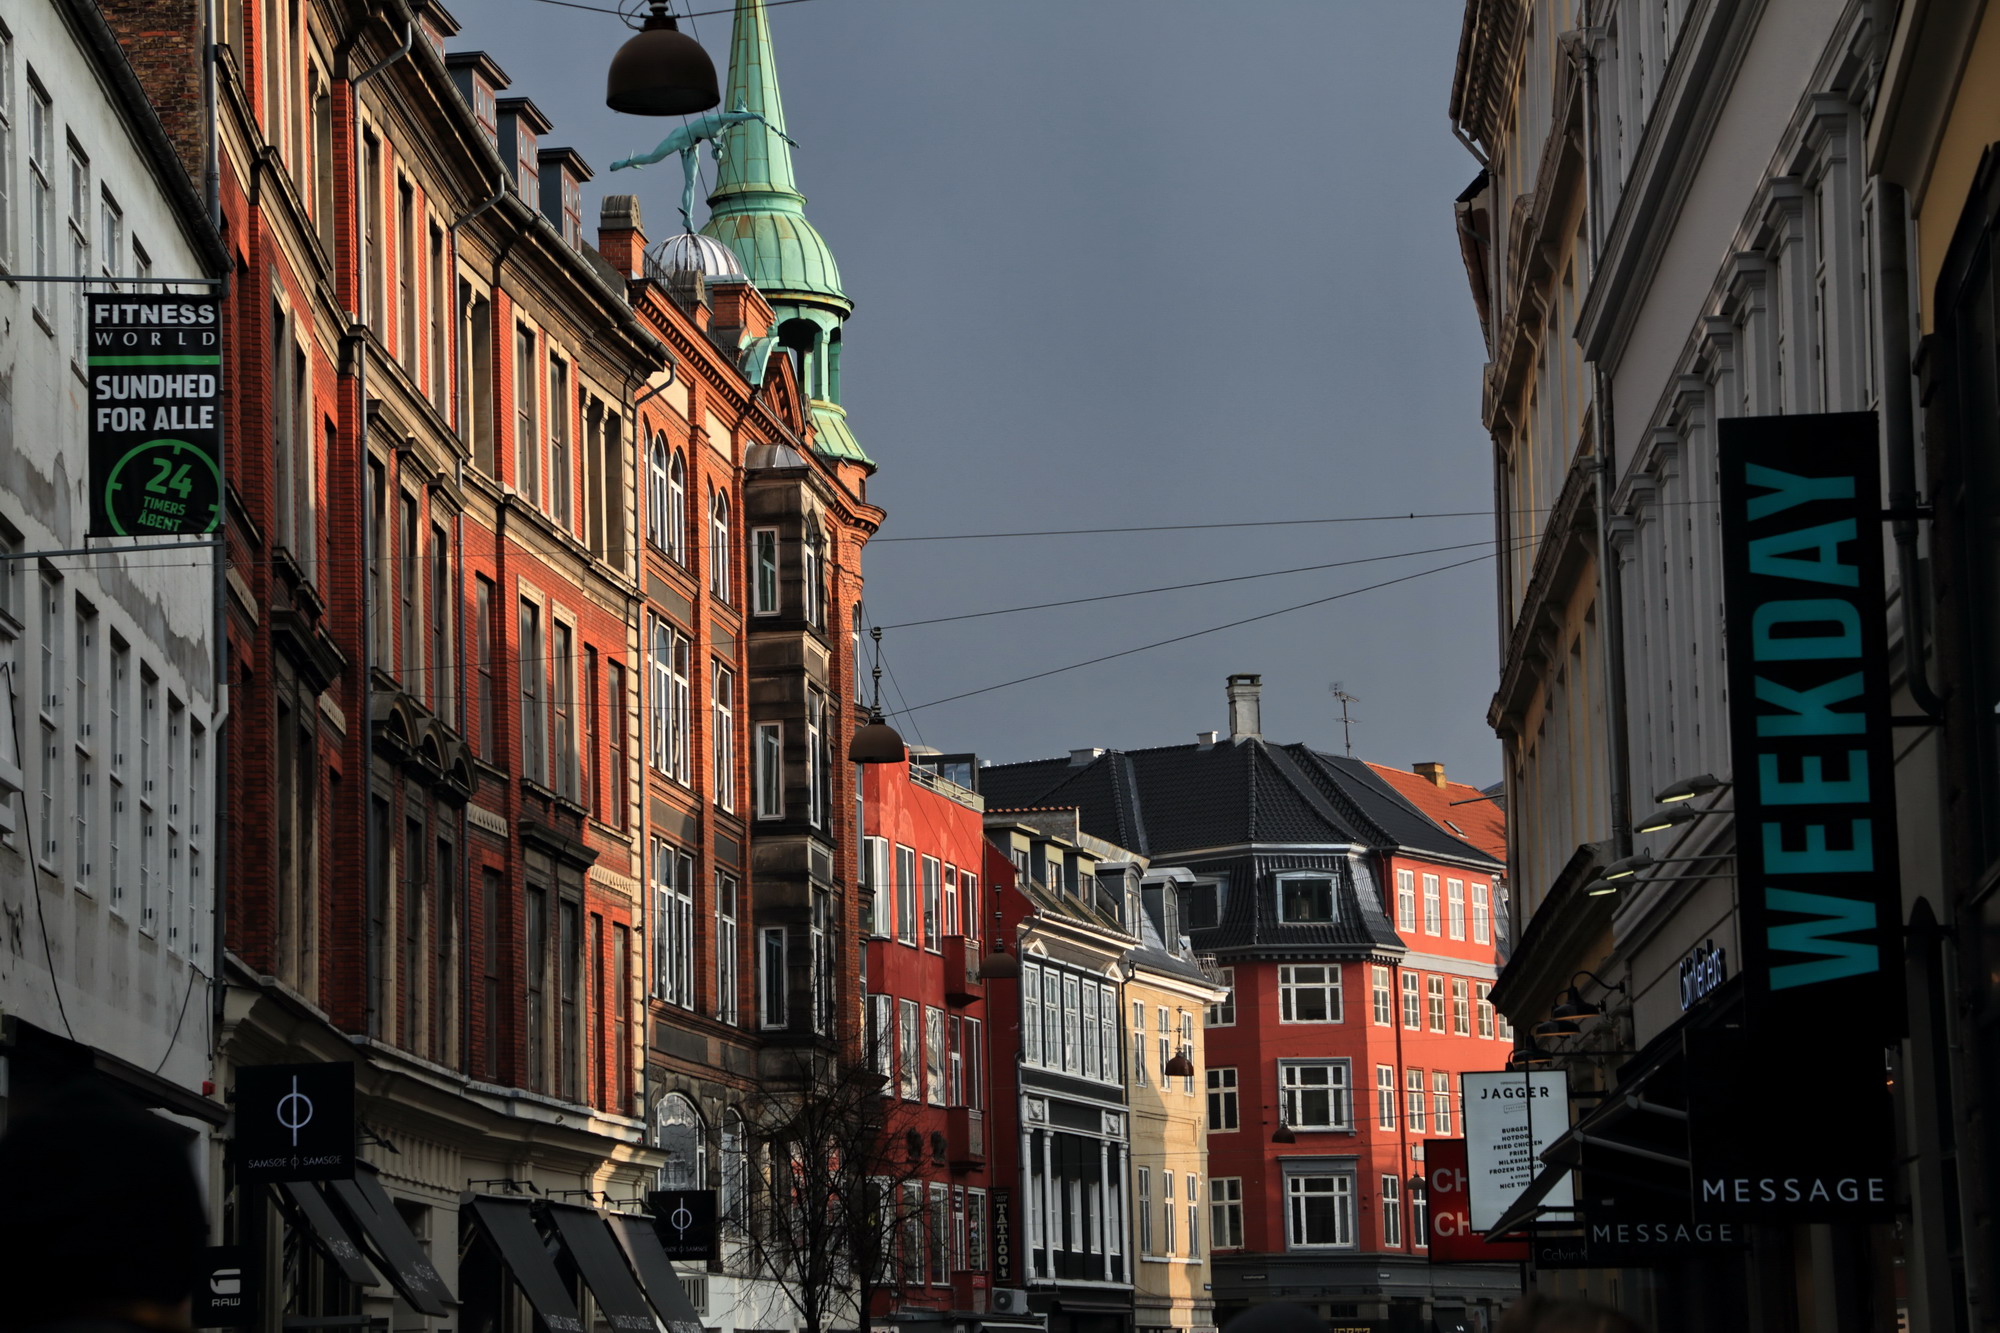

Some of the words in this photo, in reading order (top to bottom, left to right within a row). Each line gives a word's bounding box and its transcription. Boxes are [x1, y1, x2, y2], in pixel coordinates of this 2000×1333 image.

[95, 304, 215, 324] FITNESS
[95, 331, 216, 346] WORLD
[95, 374, 216, 400] SUNDHED
[97, 407, 146, 432] FOR
[153, 405, 214, 430] ALLE
[145, 457, 192, 499] 24
[142, 495, 186, 516] TIMERS
[137, 512, 182, 532] ÅBENT
[1744, 461, 1881, 992] WEEKDAY
[1481, 1087, 1550, 1100] JAGGER
[1502, 1134, 1532, 1142] HOTDOG
[248, 1156, 287, 1169] SAMSØE
[303, 1153, 343, 1166] SAMSØE
[1489, 1166, 1515, 1175] FROZEN
[1702, 1177, 1885, 1203] MESSAGE
[996, 1203, 1009, 1266] TATTOO
[1592, 1223, 1733, 1244] MESSAGE
[211, 1298, 241, 1307] RAW
